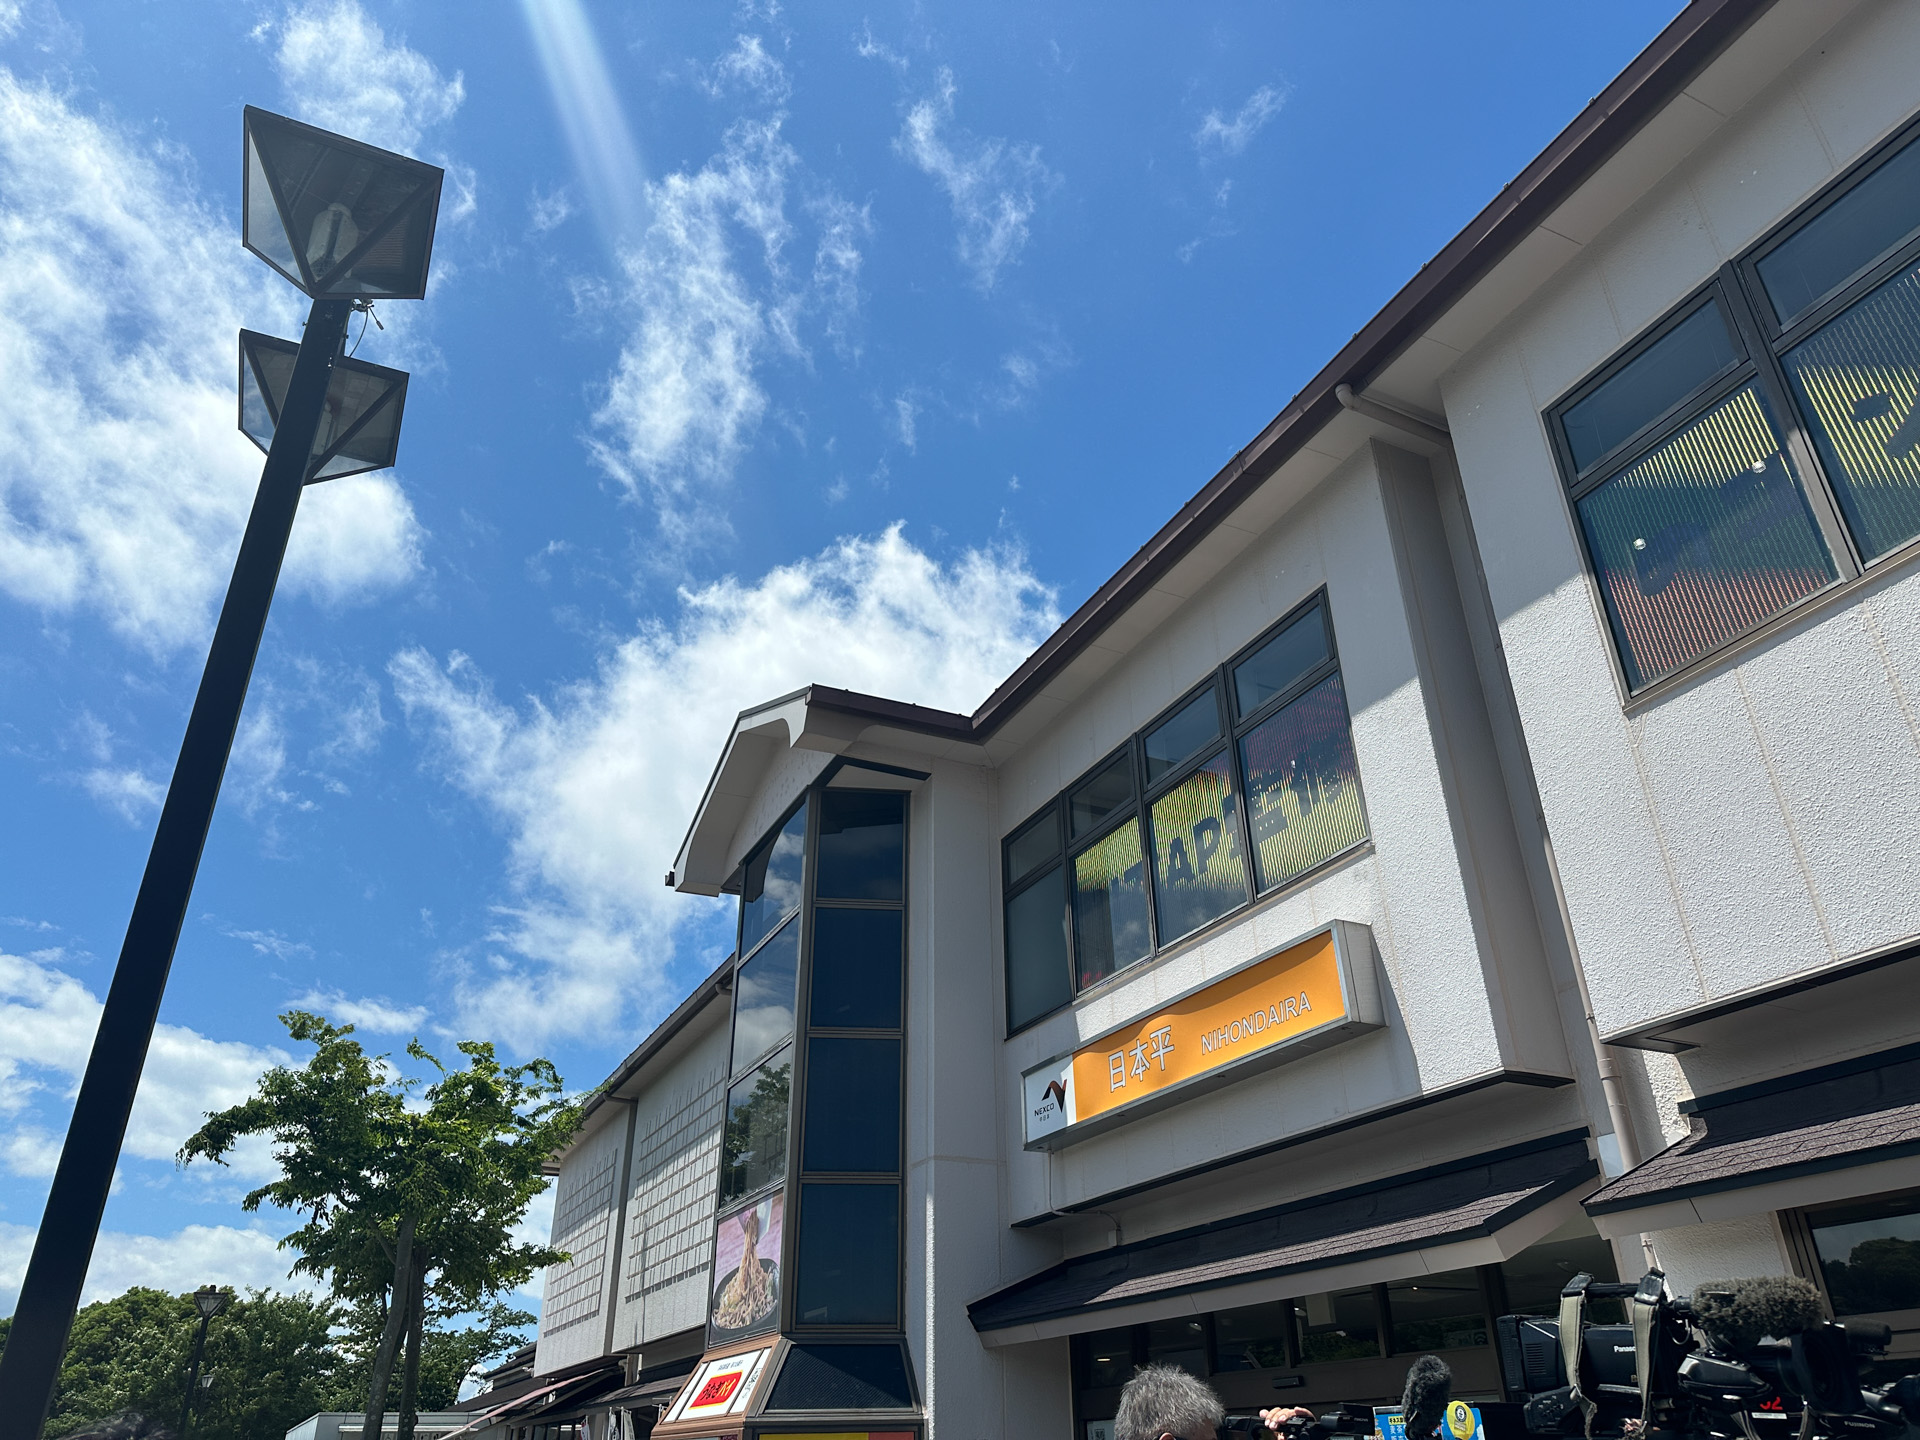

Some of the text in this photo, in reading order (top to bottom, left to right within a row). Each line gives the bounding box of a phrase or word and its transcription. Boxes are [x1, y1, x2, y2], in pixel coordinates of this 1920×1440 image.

[1200, 991, 1312, 1056] NIHONDAIRA
[1108, 1024, 1175, 1093] 日本平
[1034, 1102, 1055, 1117] NEXCO
[1613, 1345, 1637, 1353] Panaso
